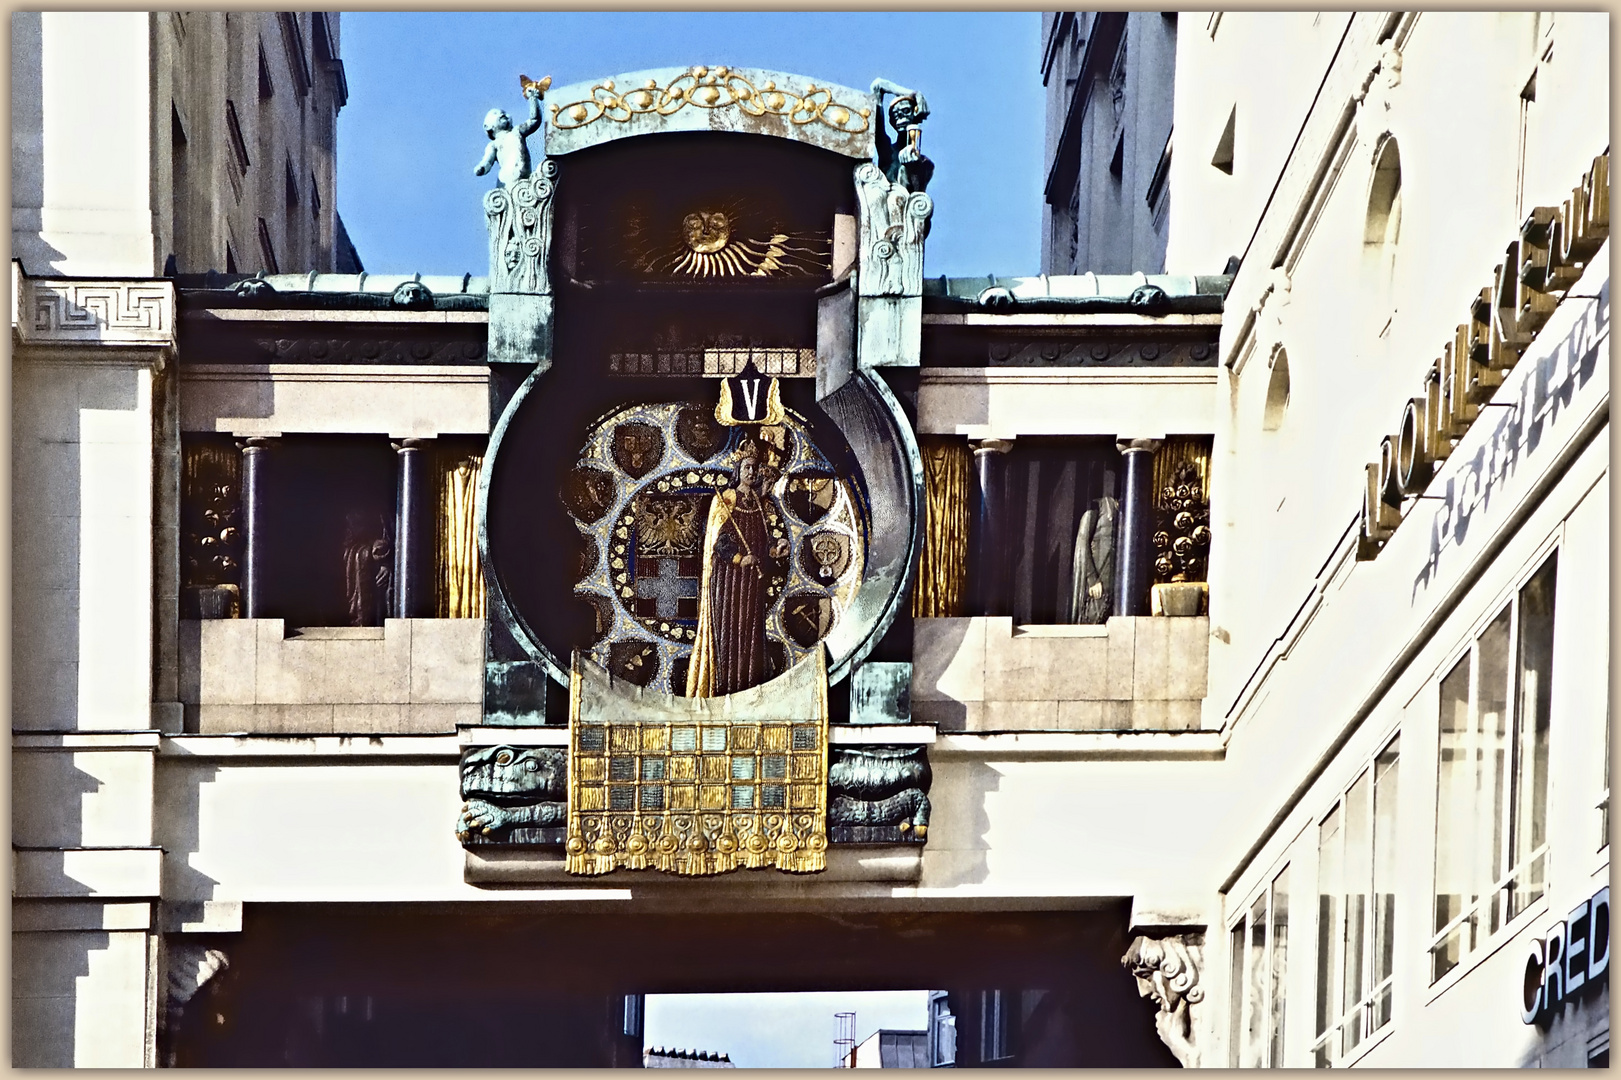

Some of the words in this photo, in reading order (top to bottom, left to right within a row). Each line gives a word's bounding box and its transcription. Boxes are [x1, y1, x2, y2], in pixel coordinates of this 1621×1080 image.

[740, 378, 761, 420] V
[1356, 207, 1552, 561] APOTHEKE
[1520, 886, 1609, 1025] CRED
